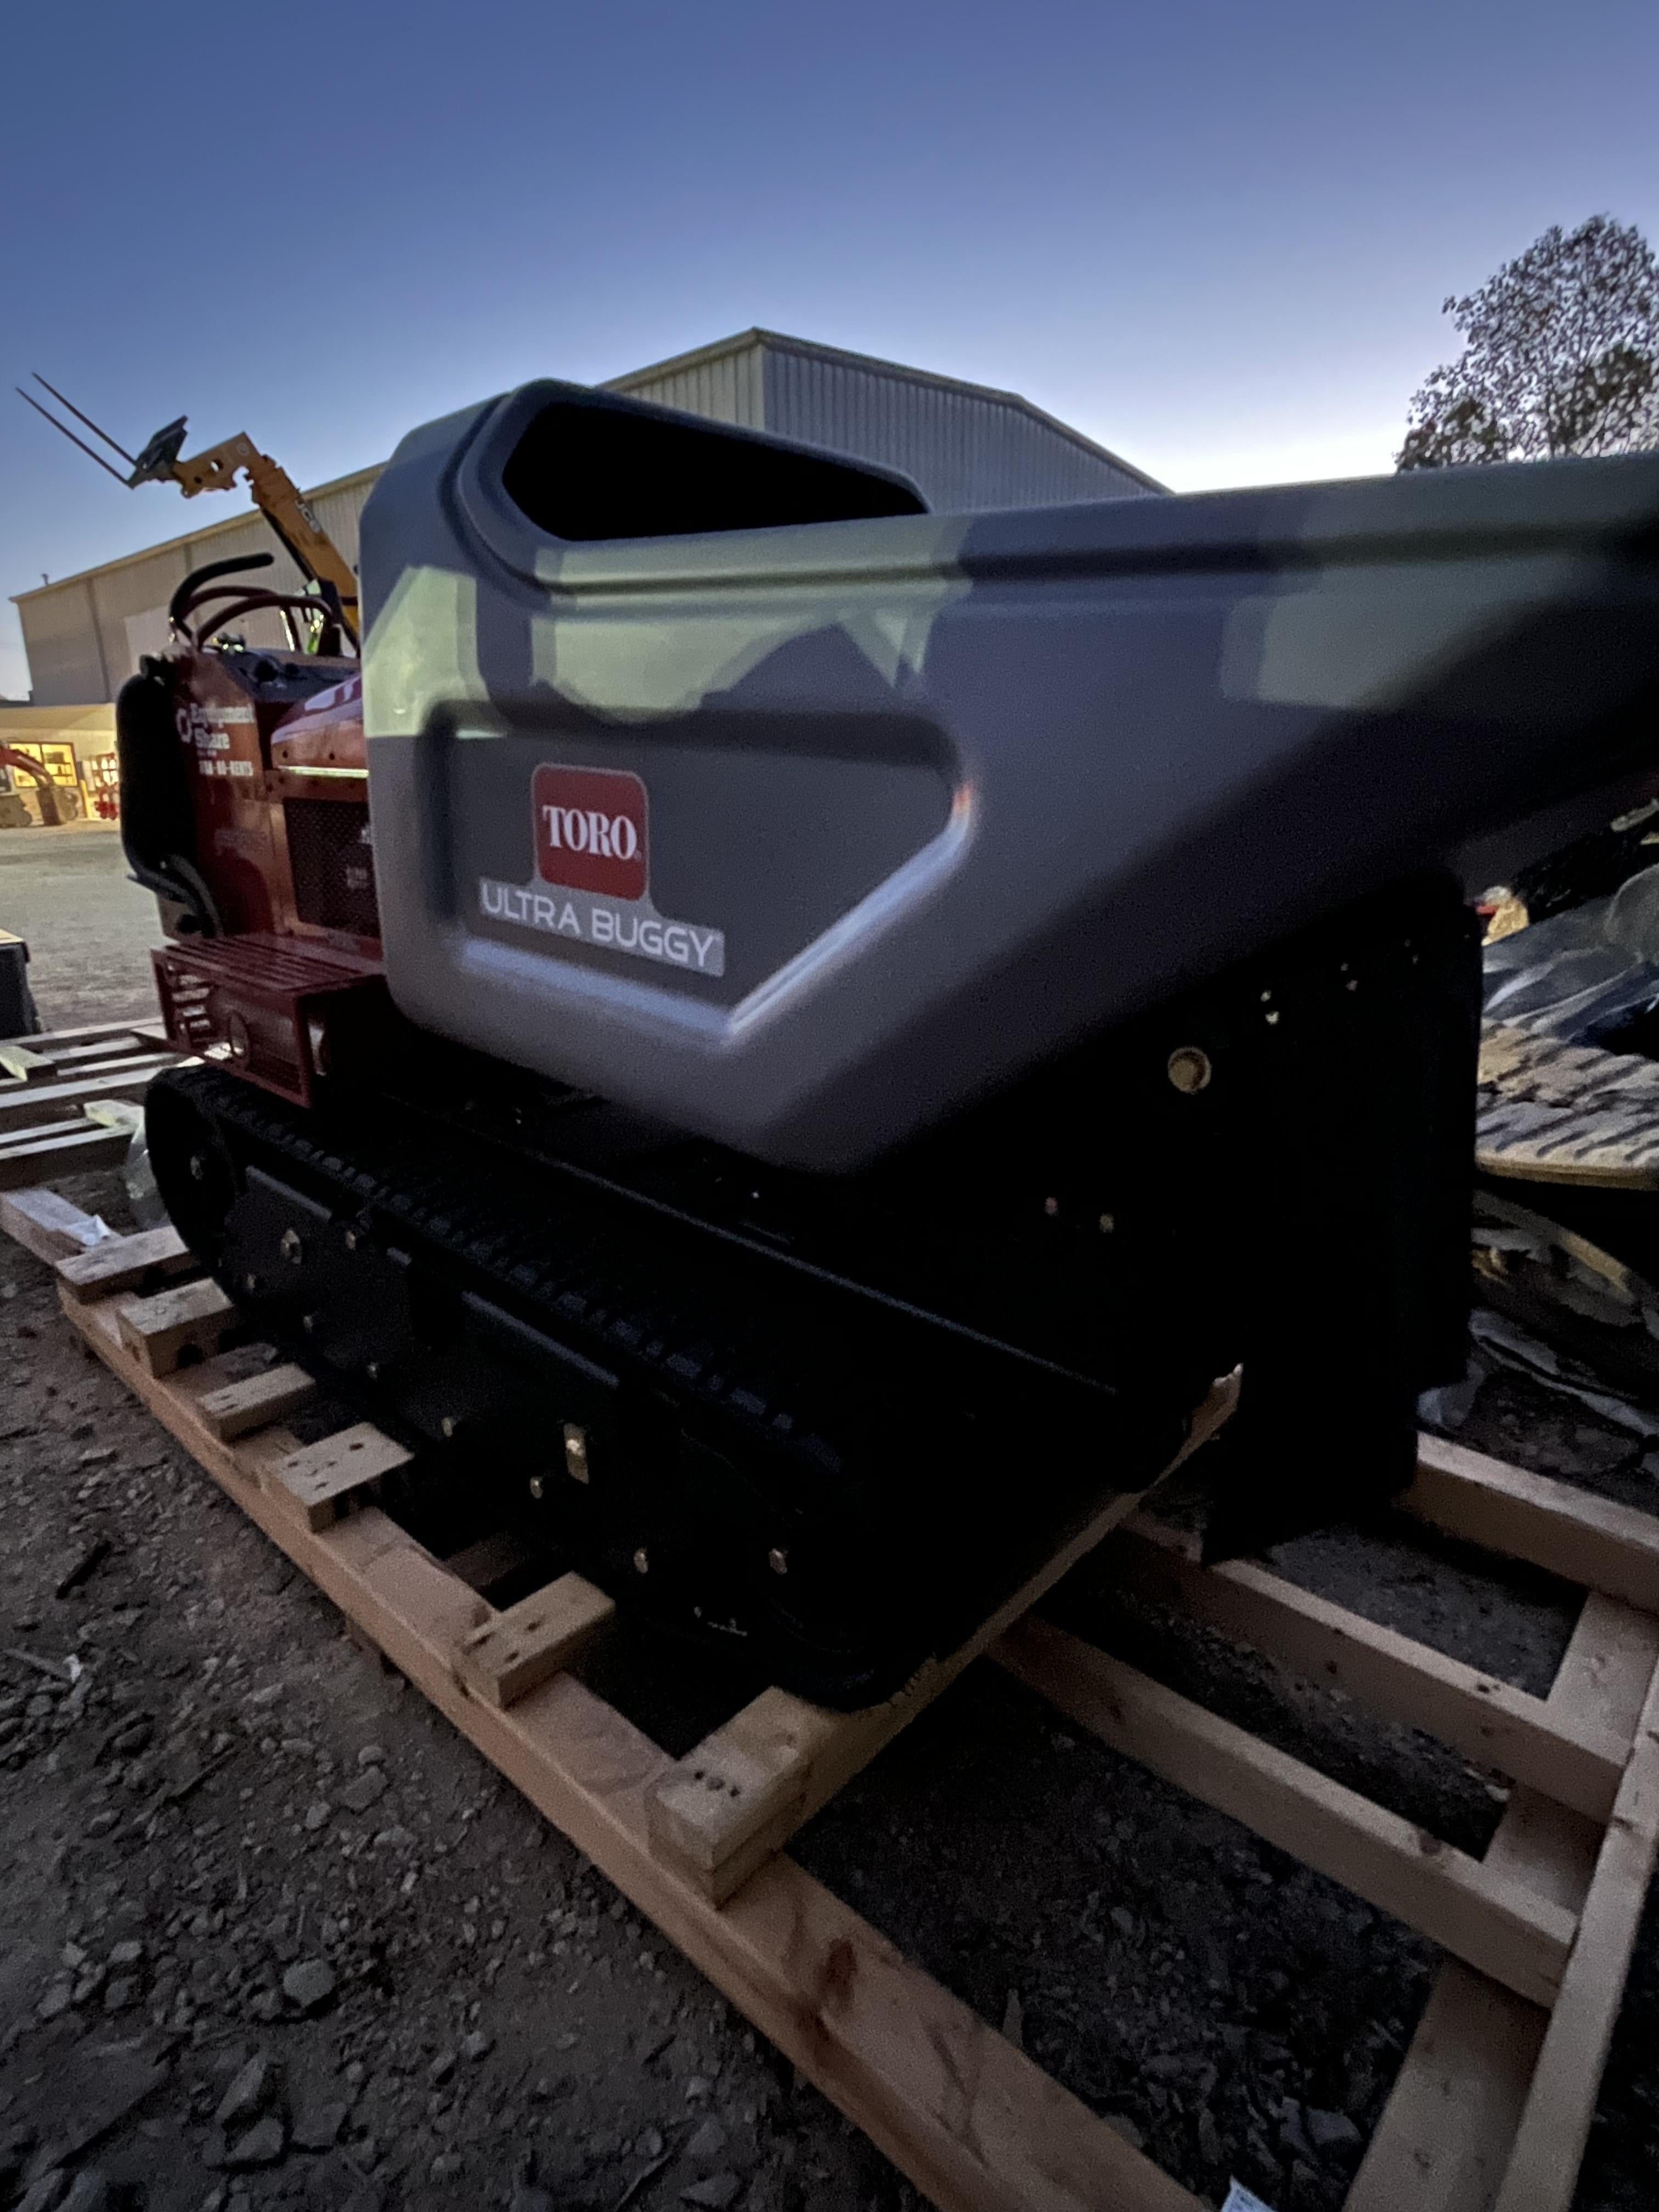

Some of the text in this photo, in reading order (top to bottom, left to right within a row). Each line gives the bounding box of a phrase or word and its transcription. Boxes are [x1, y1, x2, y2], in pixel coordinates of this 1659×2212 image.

[542, 804, 637, 860] TORO
[482, 883, 713, 967] ULTRA BUGGY
